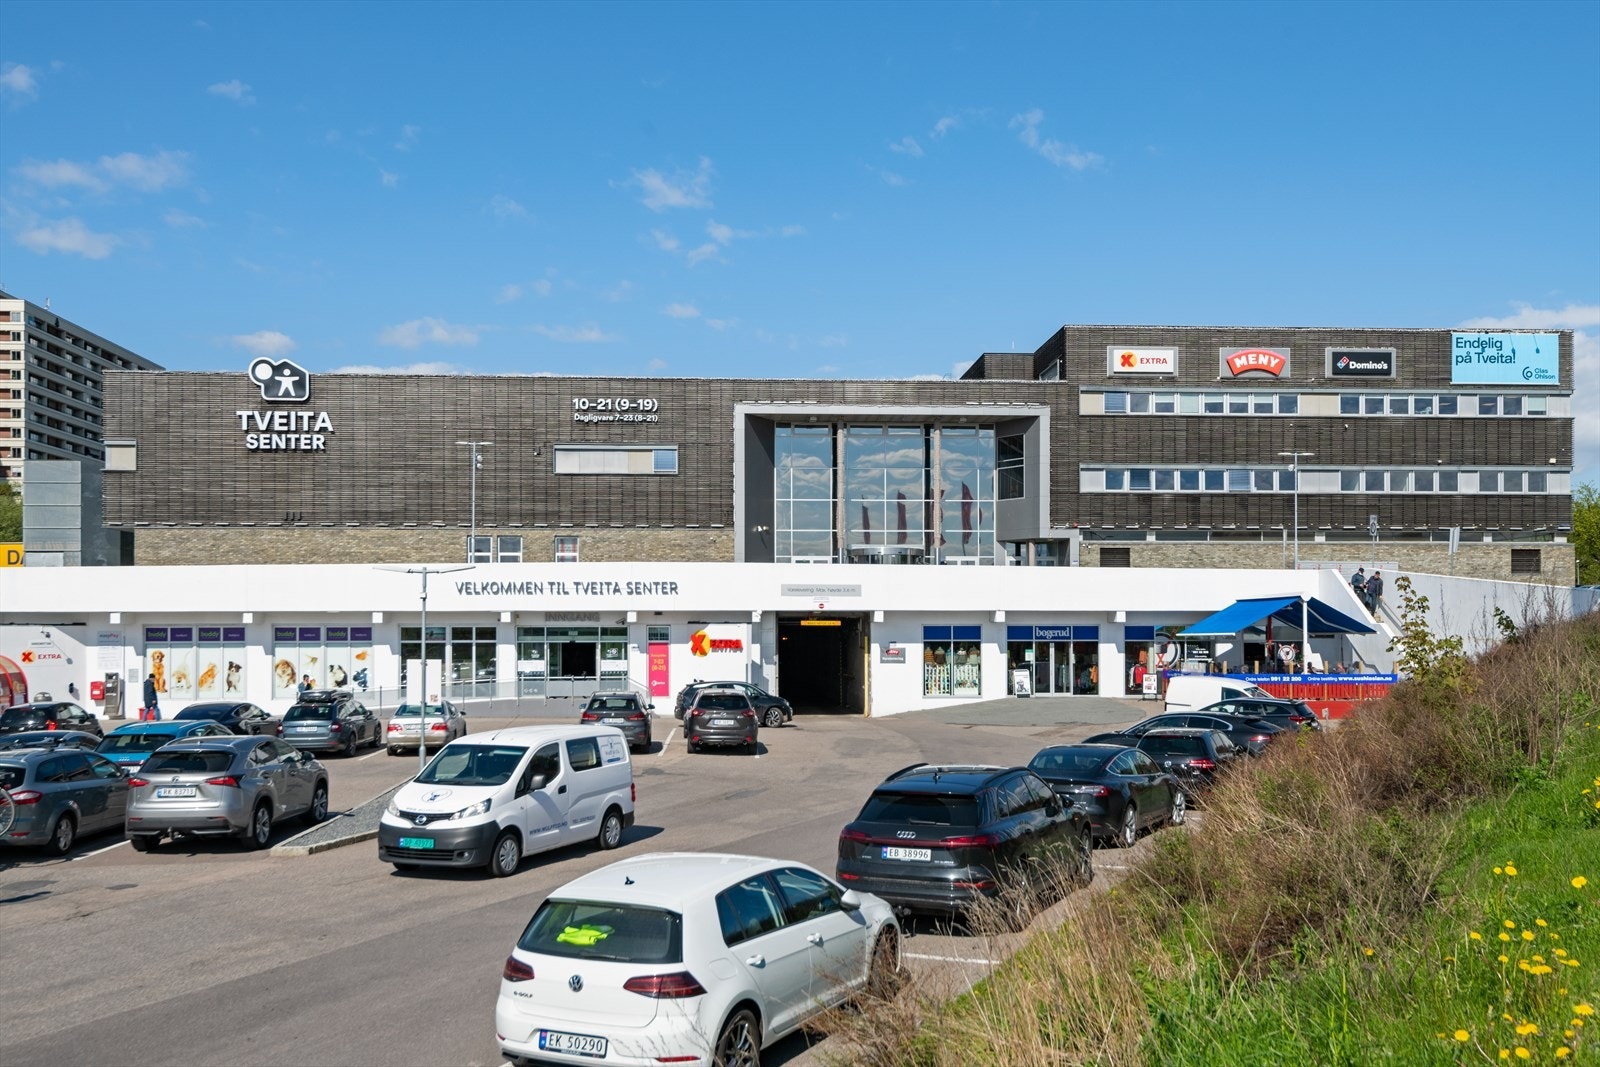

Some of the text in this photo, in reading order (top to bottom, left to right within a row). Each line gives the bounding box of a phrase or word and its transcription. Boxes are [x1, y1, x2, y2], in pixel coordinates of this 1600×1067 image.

[1455, 337, 1502, 350] Endelig
[1234, 354, 1280, 368] MENY
[1349, 360, 1388, 370] Domino's
[1455, 351, 1516, 366] på Tveita!
[236, 410, 334, 431] TVEITA
[574, 413, 614, 422] Dagligvare
[246, 434, 325, 449] SENTER
[456, 581, 679, 595] VELKOMMEN TIL TVEITA SENTER
[545, 612, 601, 622] INNGANG
[1036, 626, 1070, 639] bogerud
[710, 639, 743, 651] EXTRA
[902, 850, 928, 859] 38996
[548, 1033, 562, 1047] EK
[568, 1036, 603, 1052] 50290
